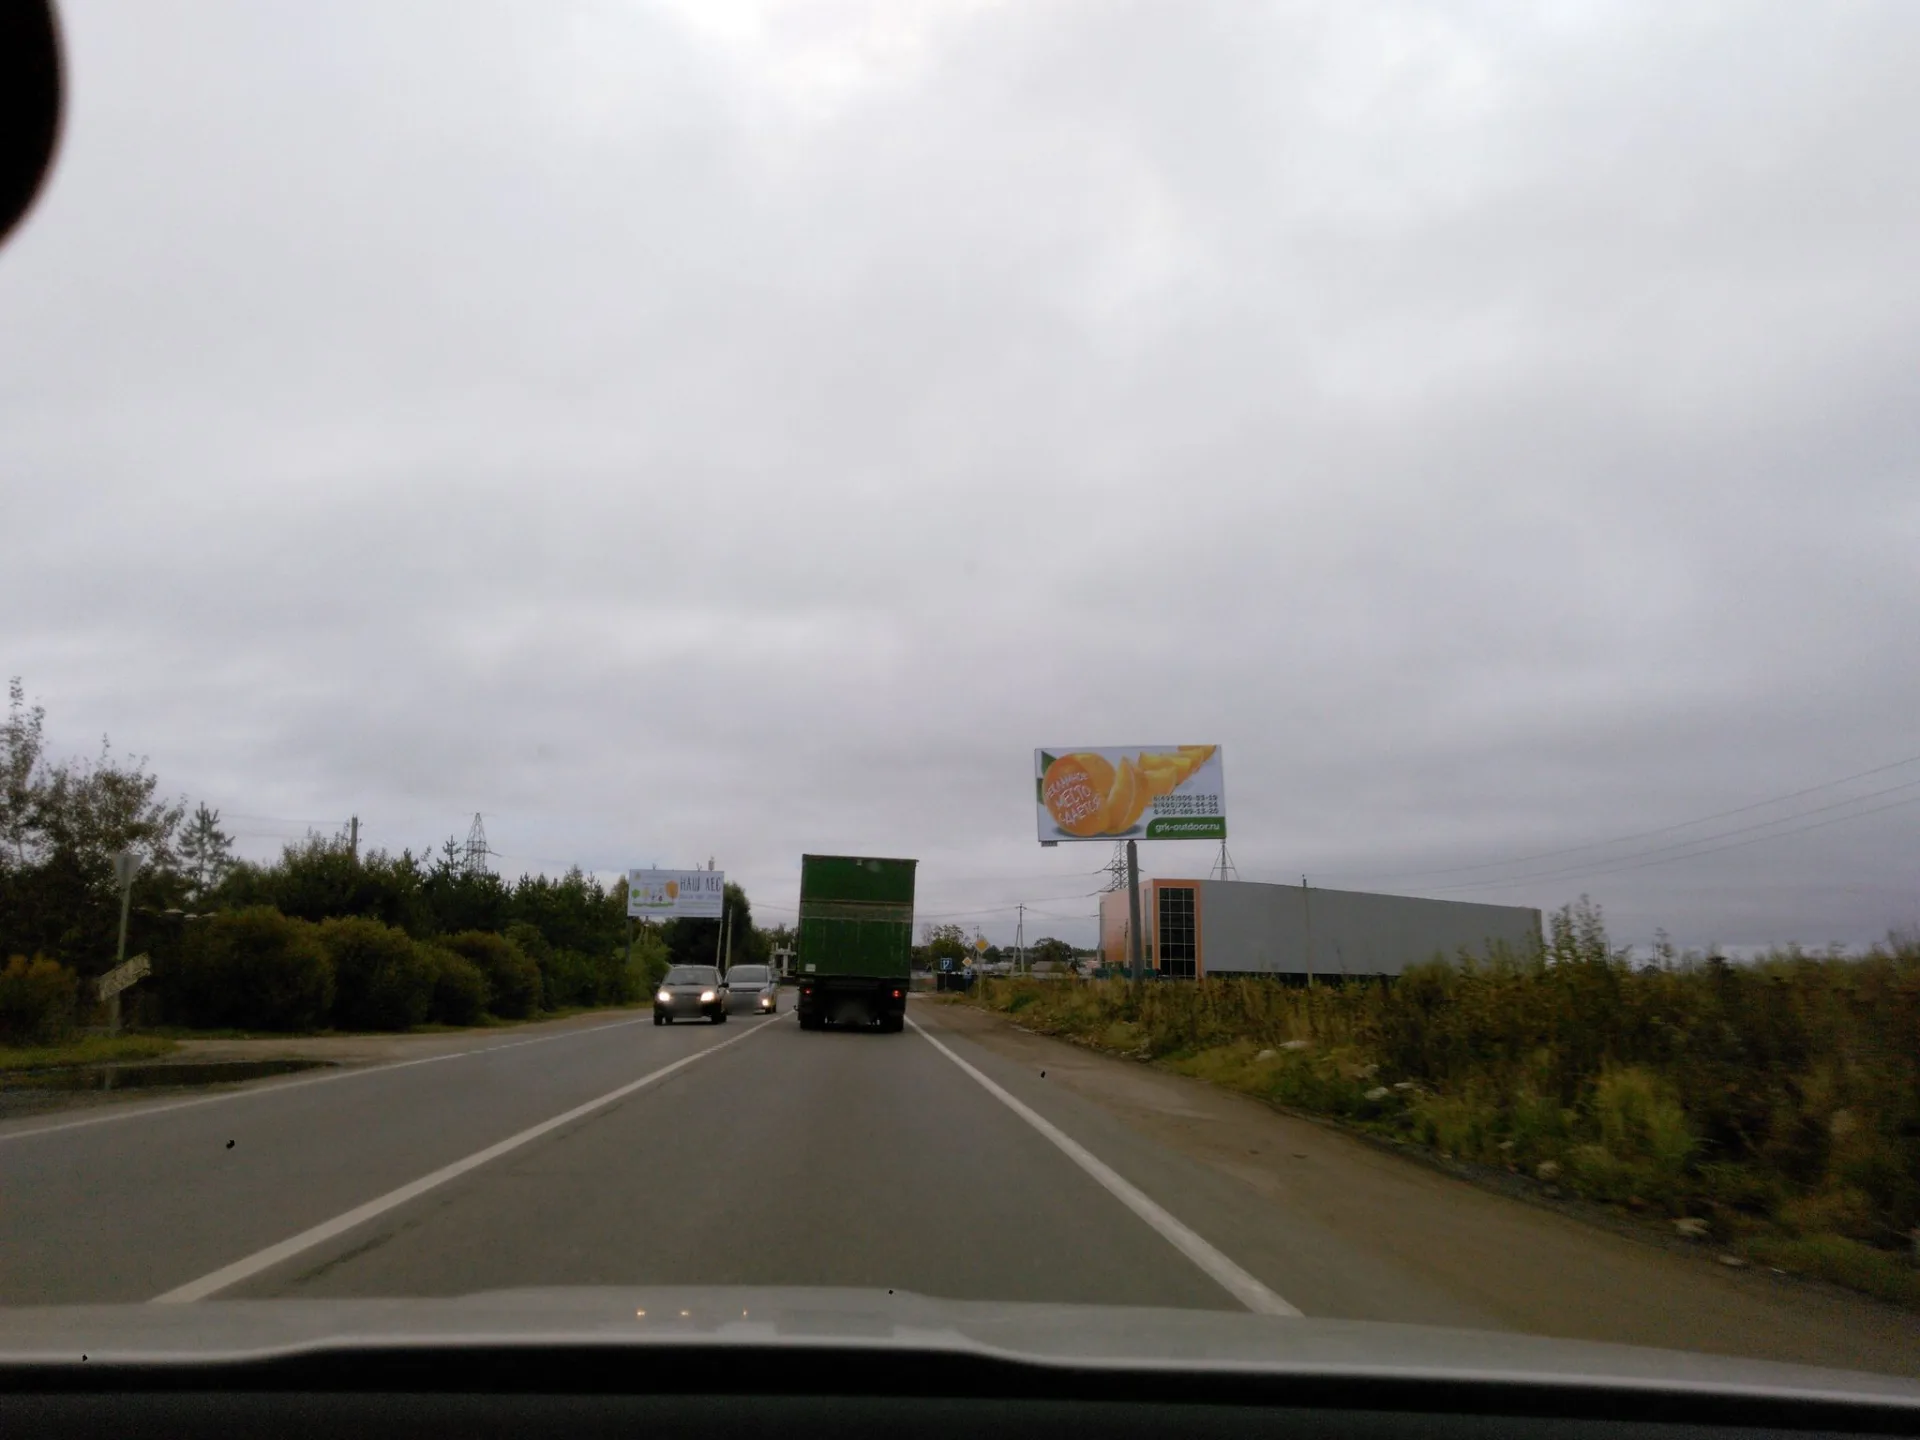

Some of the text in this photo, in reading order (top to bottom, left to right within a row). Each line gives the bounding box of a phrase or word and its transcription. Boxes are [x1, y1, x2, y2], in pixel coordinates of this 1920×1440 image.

[1055, 784, 1092, 809] МЕСТО
[1155, 823, 1220, 834] grk-outdoor.ru
[680, 876, 721, 893] НАШ ЛЕС
